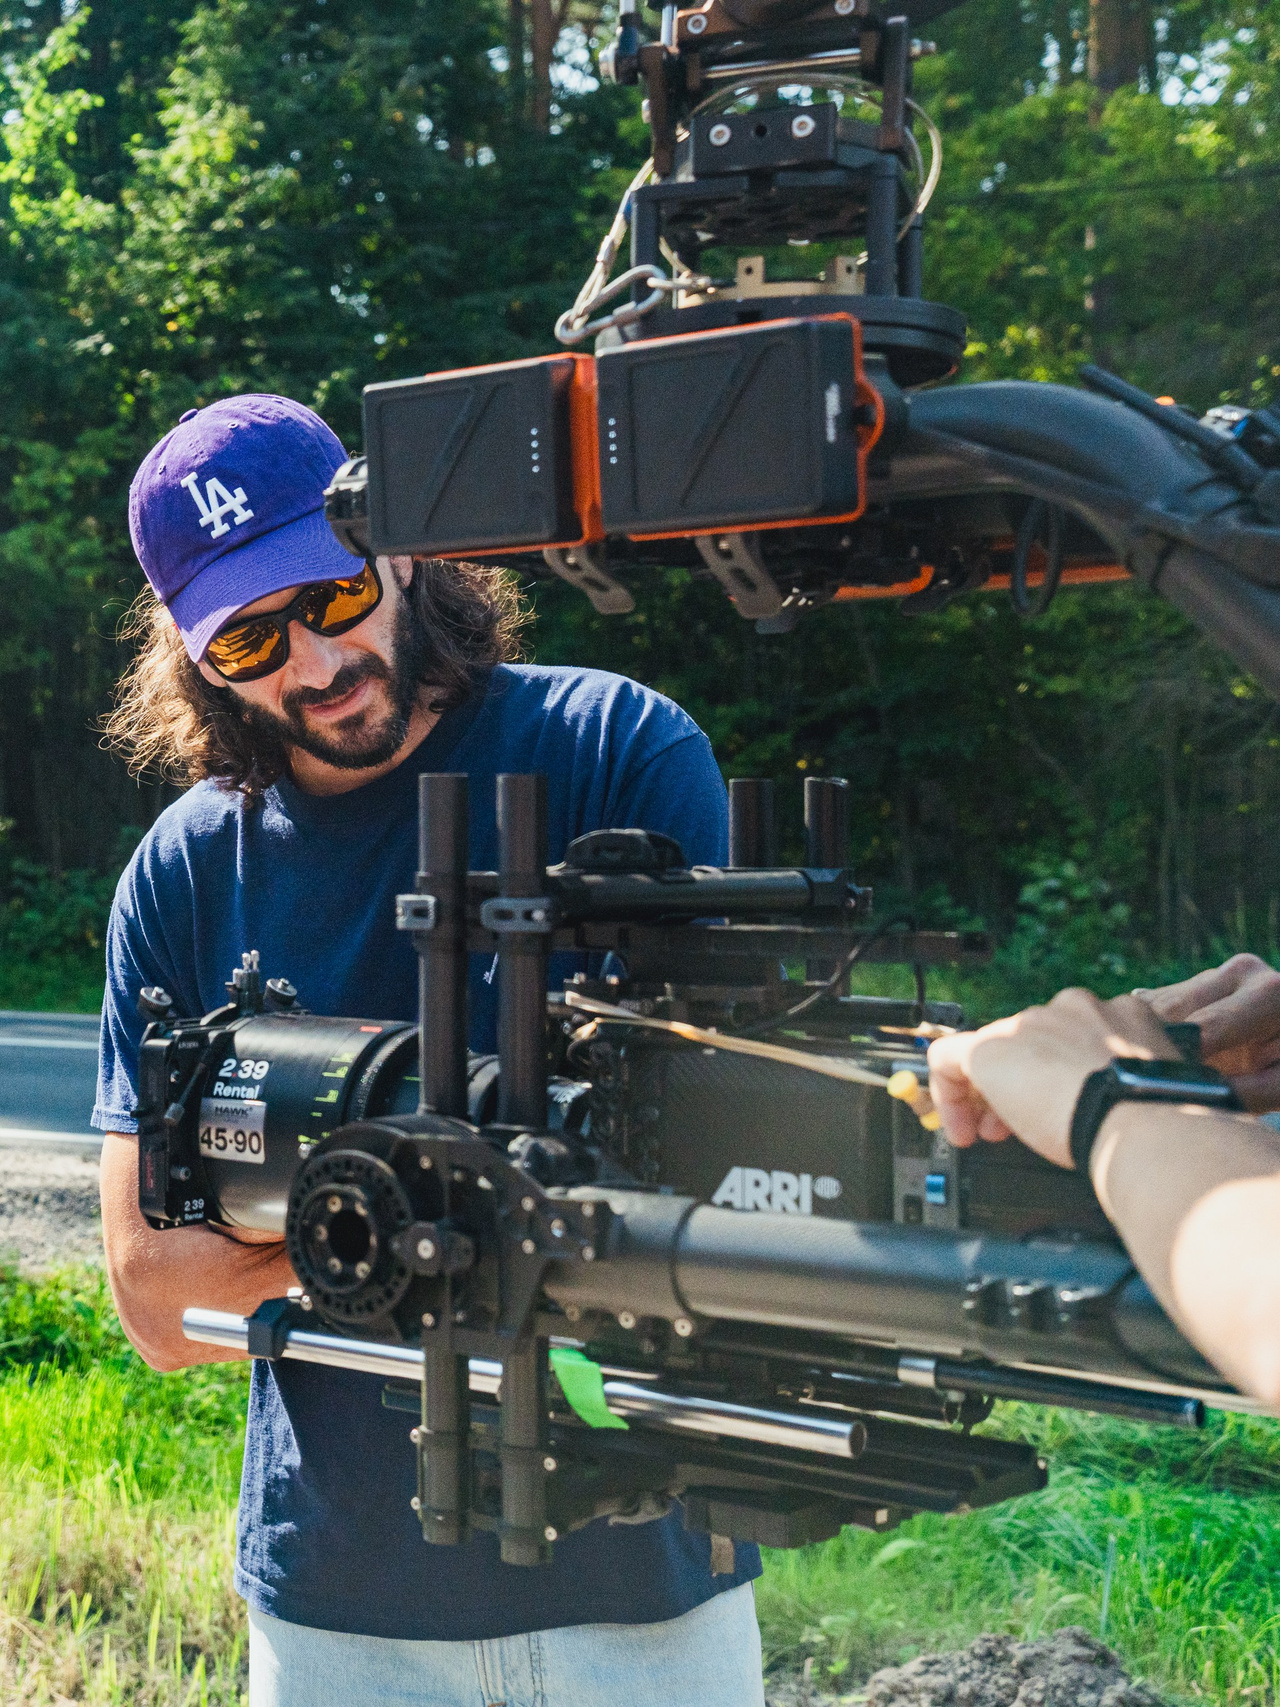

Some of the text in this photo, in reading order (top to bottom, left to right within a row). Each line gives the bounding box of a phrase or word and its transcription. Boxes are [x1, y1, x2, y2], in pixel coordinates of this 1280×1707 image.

[180, 471, 255, 539] LA
[218, 1058, 269, 1080] 2.39
[213, 1081, 260, 1099] Rental
[711, 1166, 813, 1215] ARRI
